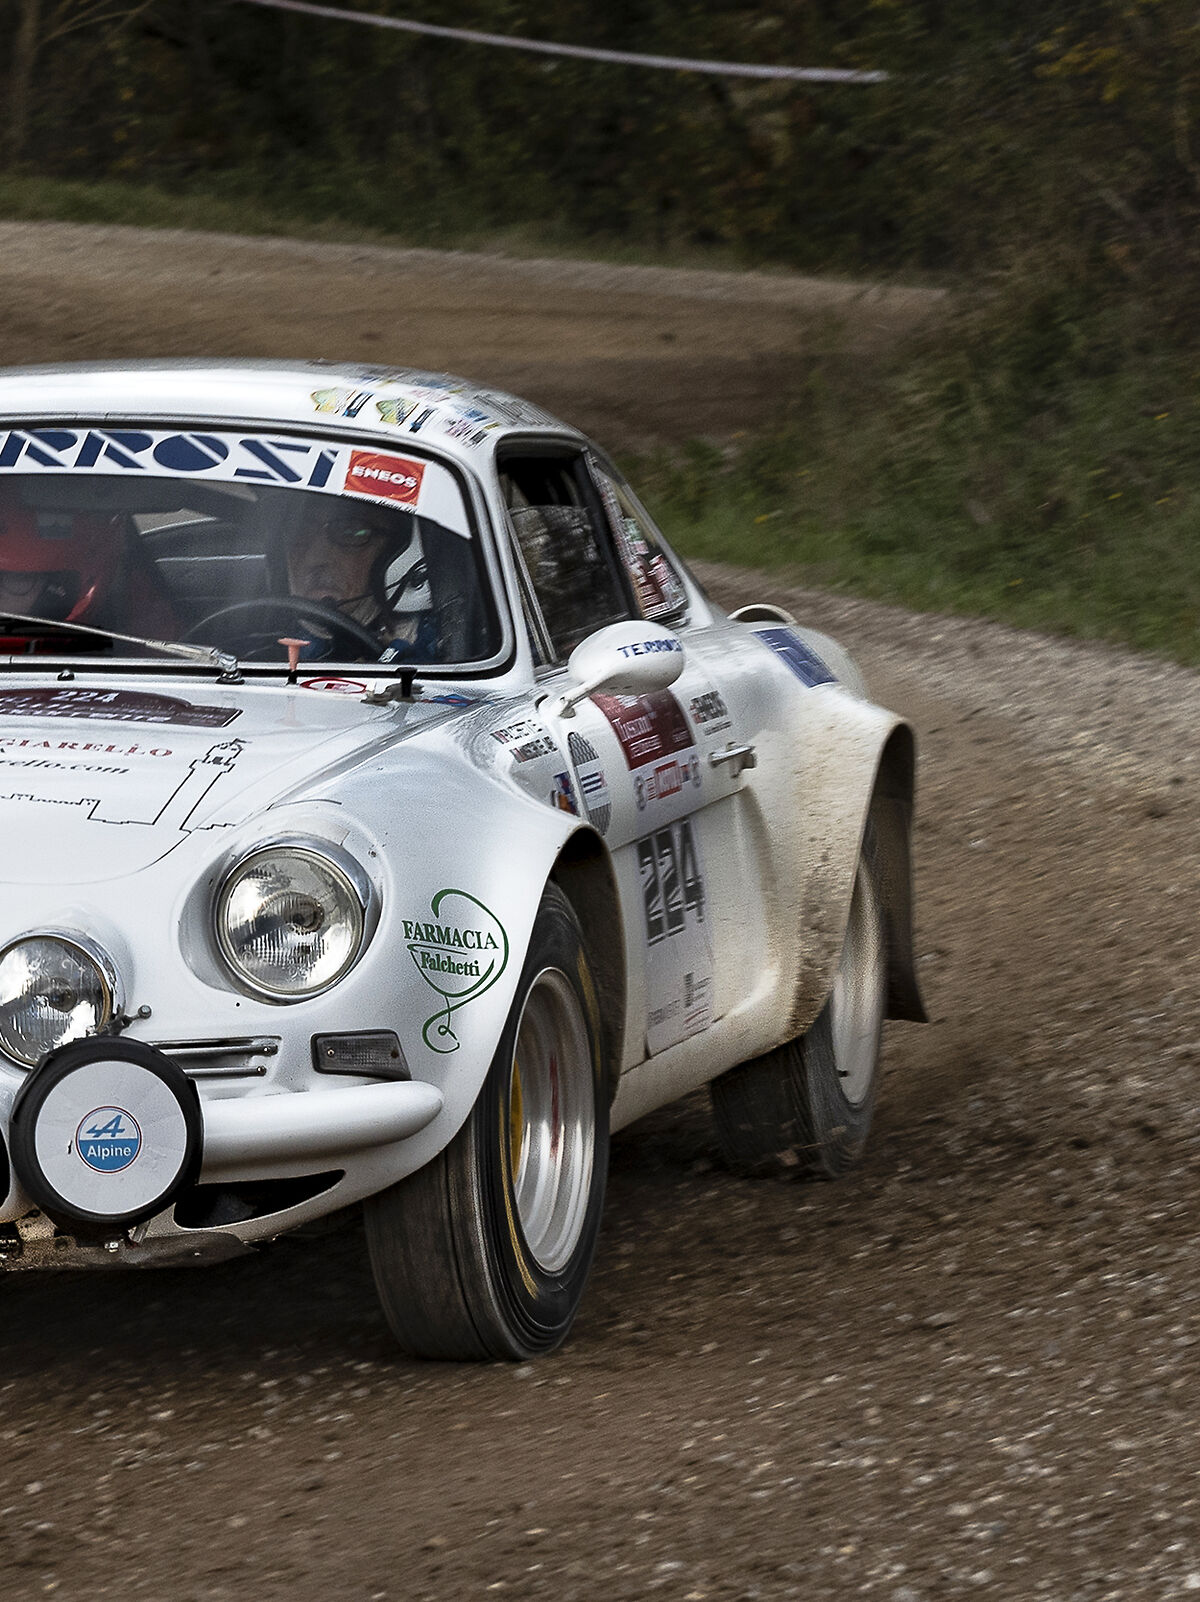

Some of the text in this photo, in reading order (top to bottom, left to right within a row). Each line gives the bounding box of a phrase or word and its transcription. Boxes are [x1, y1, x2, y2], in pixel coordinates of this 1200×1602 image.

[351, 464, 418, 489] ENEOS
[50, 690, 120, 703] 224
[637, 819, 704, 947] 224
[402, 920, 499, 950] FARMACIA
[420, 951, 480, 977] Falchetti
[87, 1144, 132, 1160] Alpine
